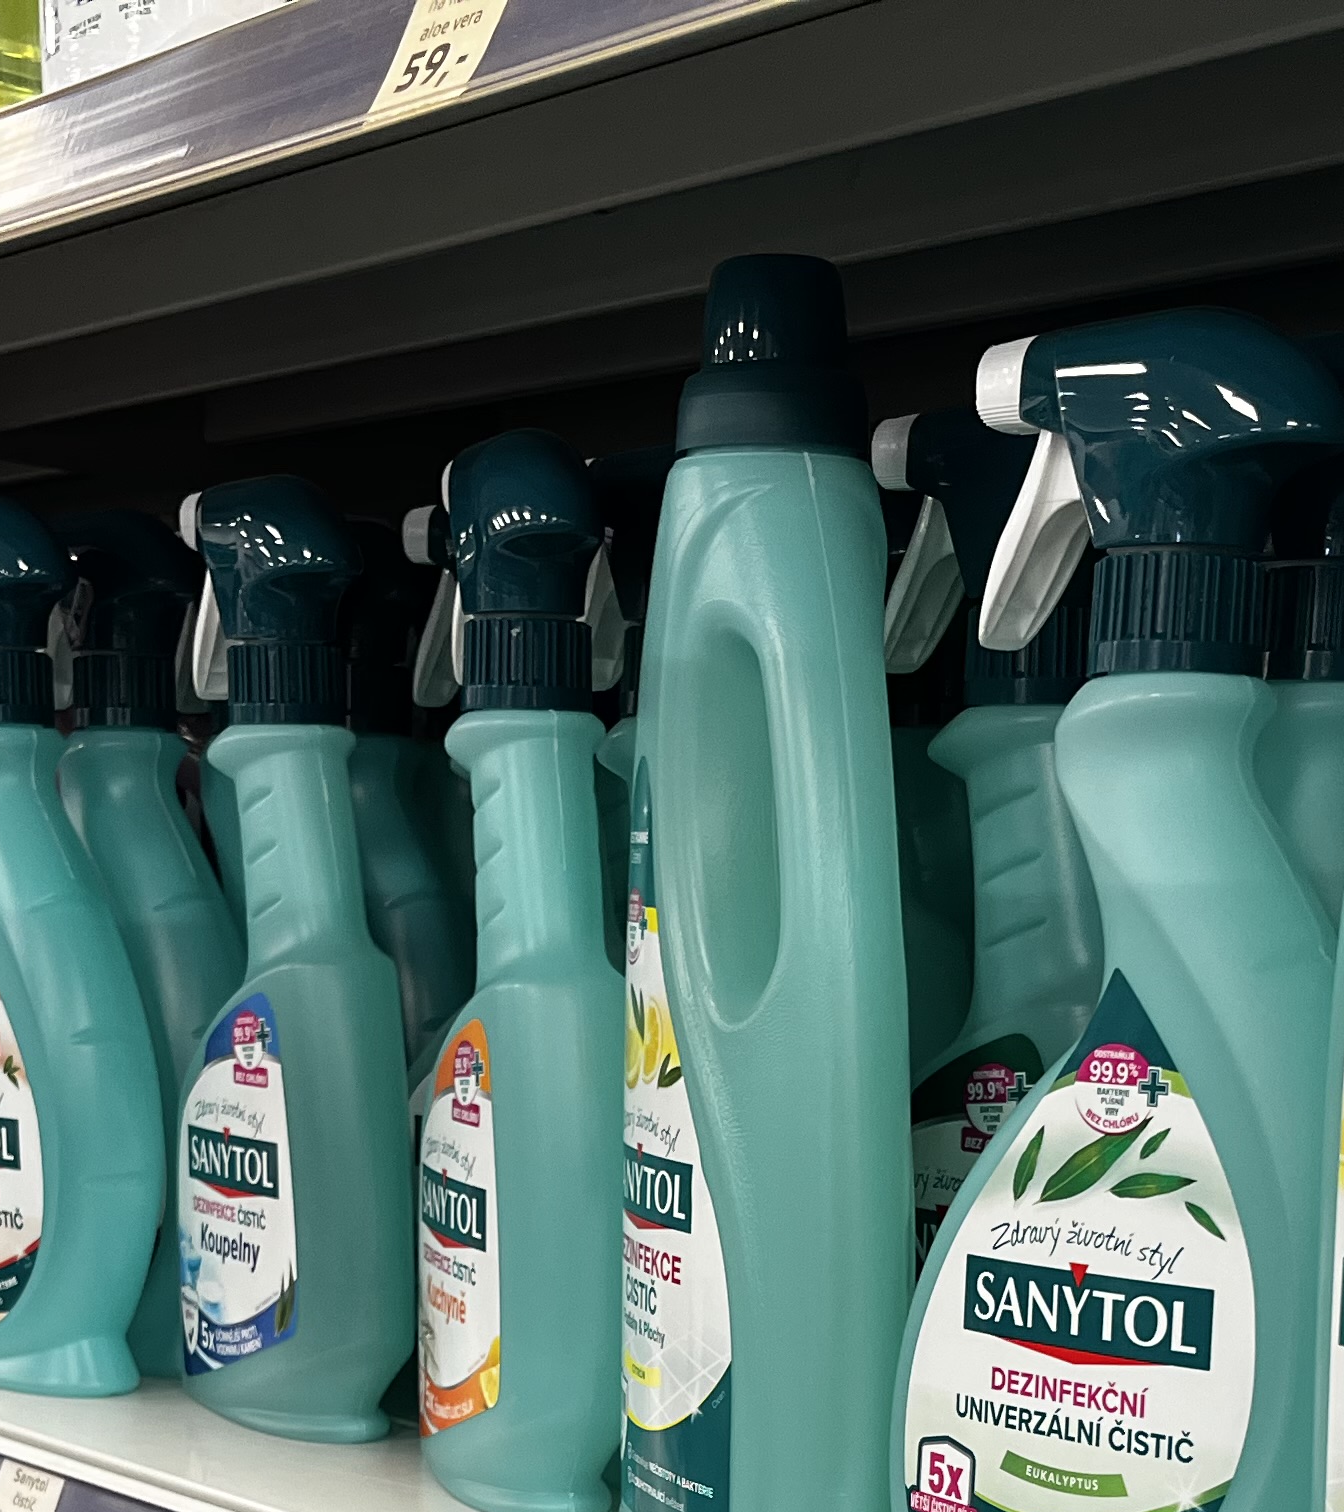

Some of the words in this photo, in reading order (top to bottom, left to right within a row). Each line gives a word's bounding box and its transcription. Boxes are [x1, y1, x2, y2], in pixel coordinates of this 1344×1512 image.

[420, 20, 450, 41] aloe
[453, 9, 483, 31] vera
[393, 42, 469, 93] 59,-
[191, 1133, 274, 1189] SANYTOL
[622, 1158, 686, 1220] NYTOL
[200, 1222, 261, 1273] Koupelny
[973, 1270, 1198, 1355] SANYTOL
[990, 1366, 1150, 1419] DEZINFEKČNÍ
[955, 1393, 1105, 1449] UNIVERZÁLNÍ
[1108, 1420, 1195, 1464] ČISTIČ
[13, 1468, 49, 1493] Sanytol
[1025, 1464, 1099, 1492] EUKALYPTUS
